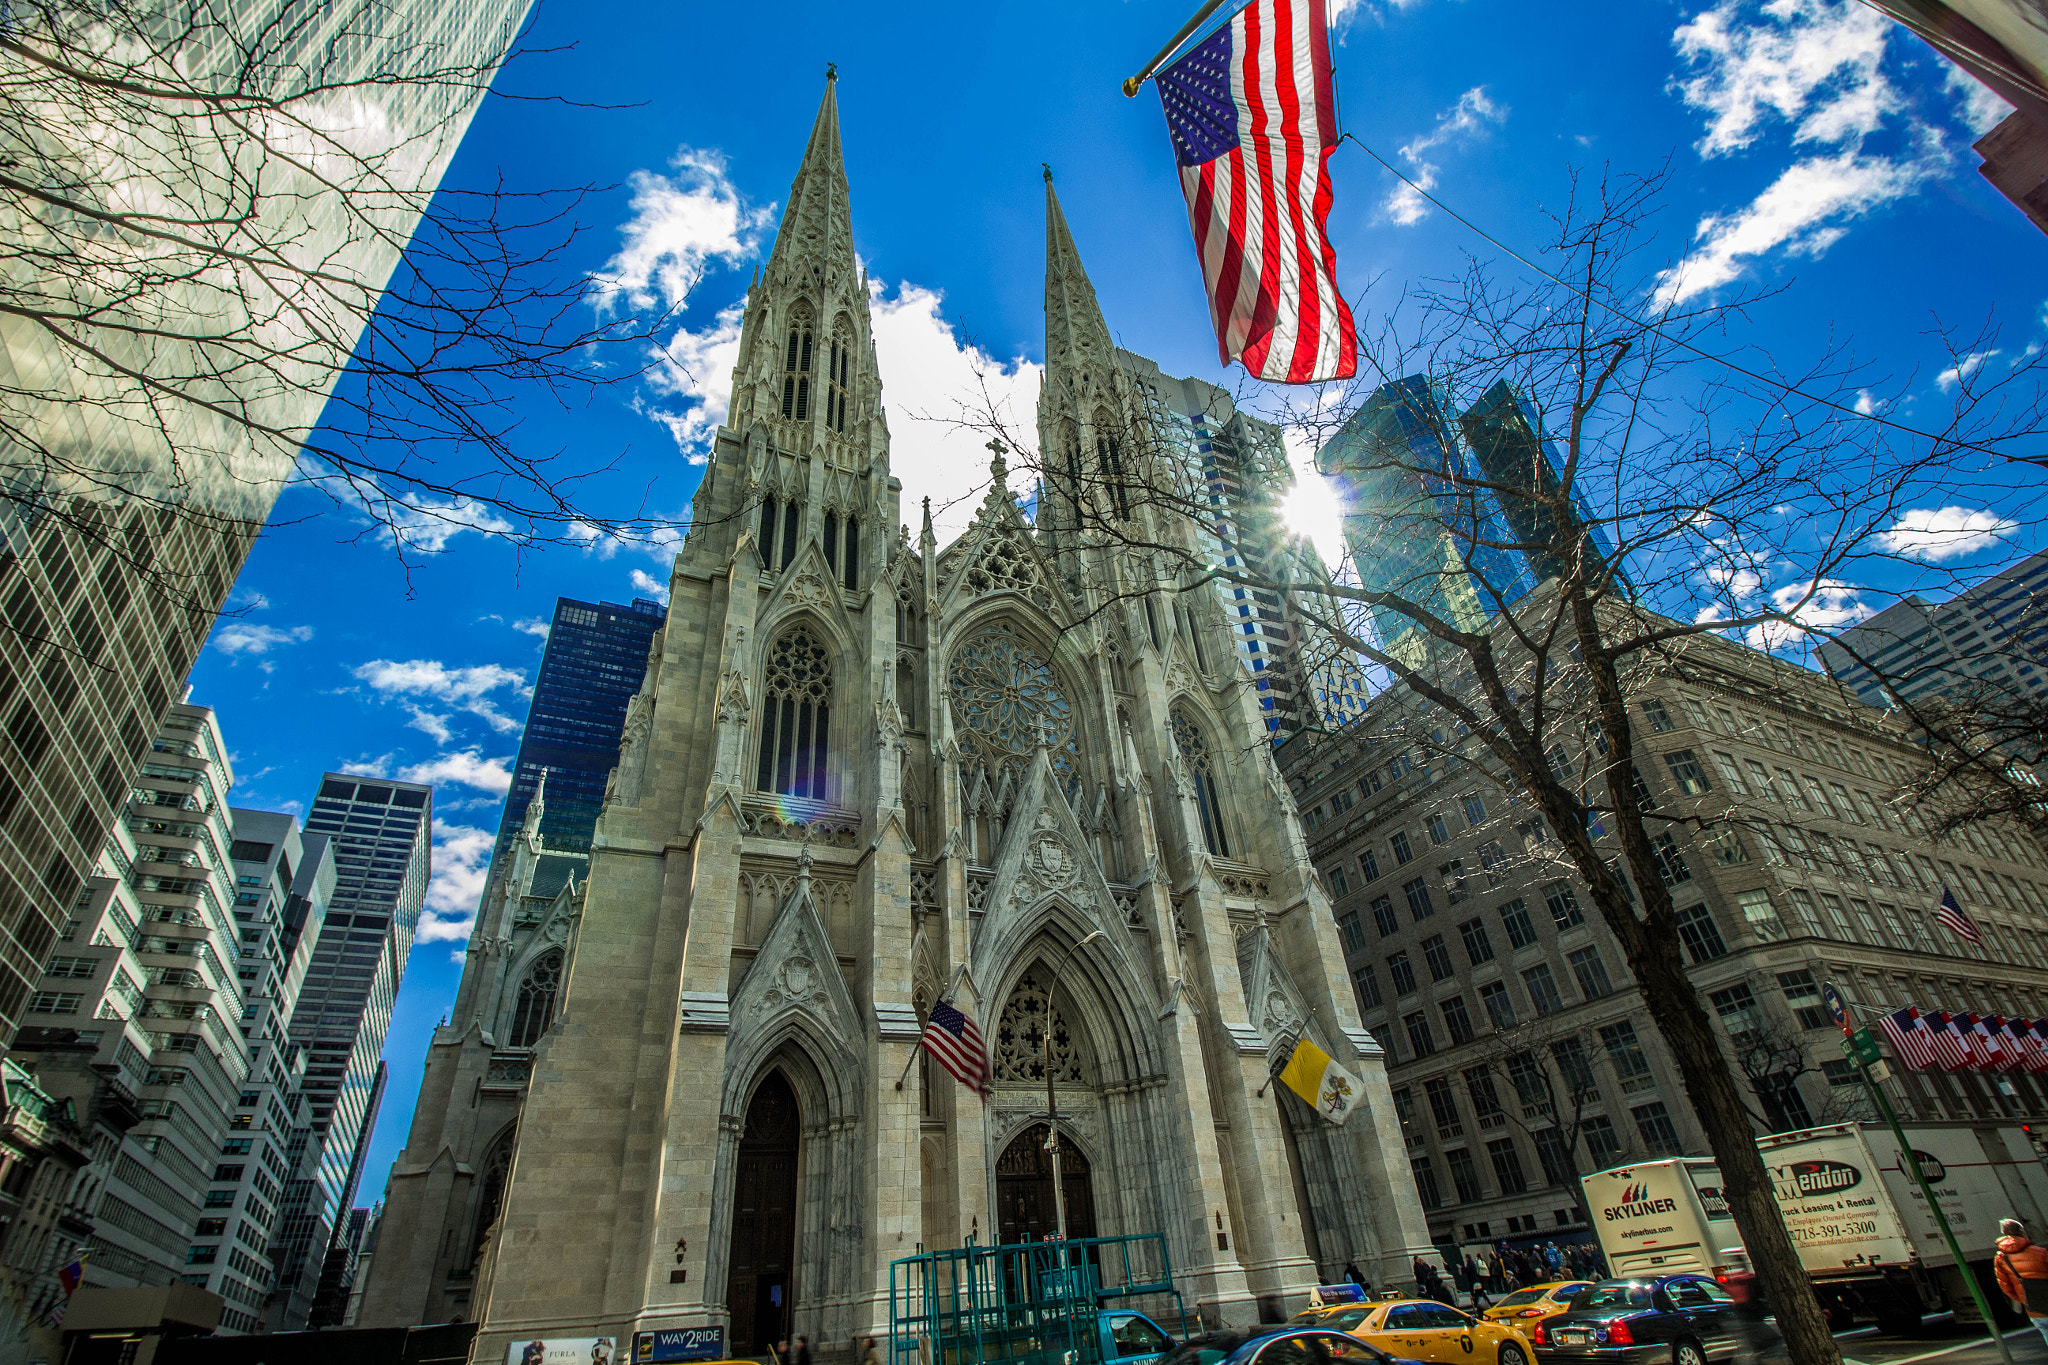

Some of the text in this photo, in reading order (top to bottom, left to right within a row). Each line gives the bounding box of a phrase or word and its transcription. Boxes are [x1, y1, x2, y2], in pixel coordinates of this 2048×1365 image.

[1767, 1165, 1855, 1200] Mendon
[1604, 1198, 1677, 1221] SKYLINER
[1780, 1197, 1876, 1217] ruck Leasing & Rental
[1823, 1213, 1845, 1222] Owned
[1620, 1225, 1673, 1239] skylinerbus.com
[1794, 1220, 1876, 1241] 718-391-5300
[549, 1350, 576, 1358] FURLA
